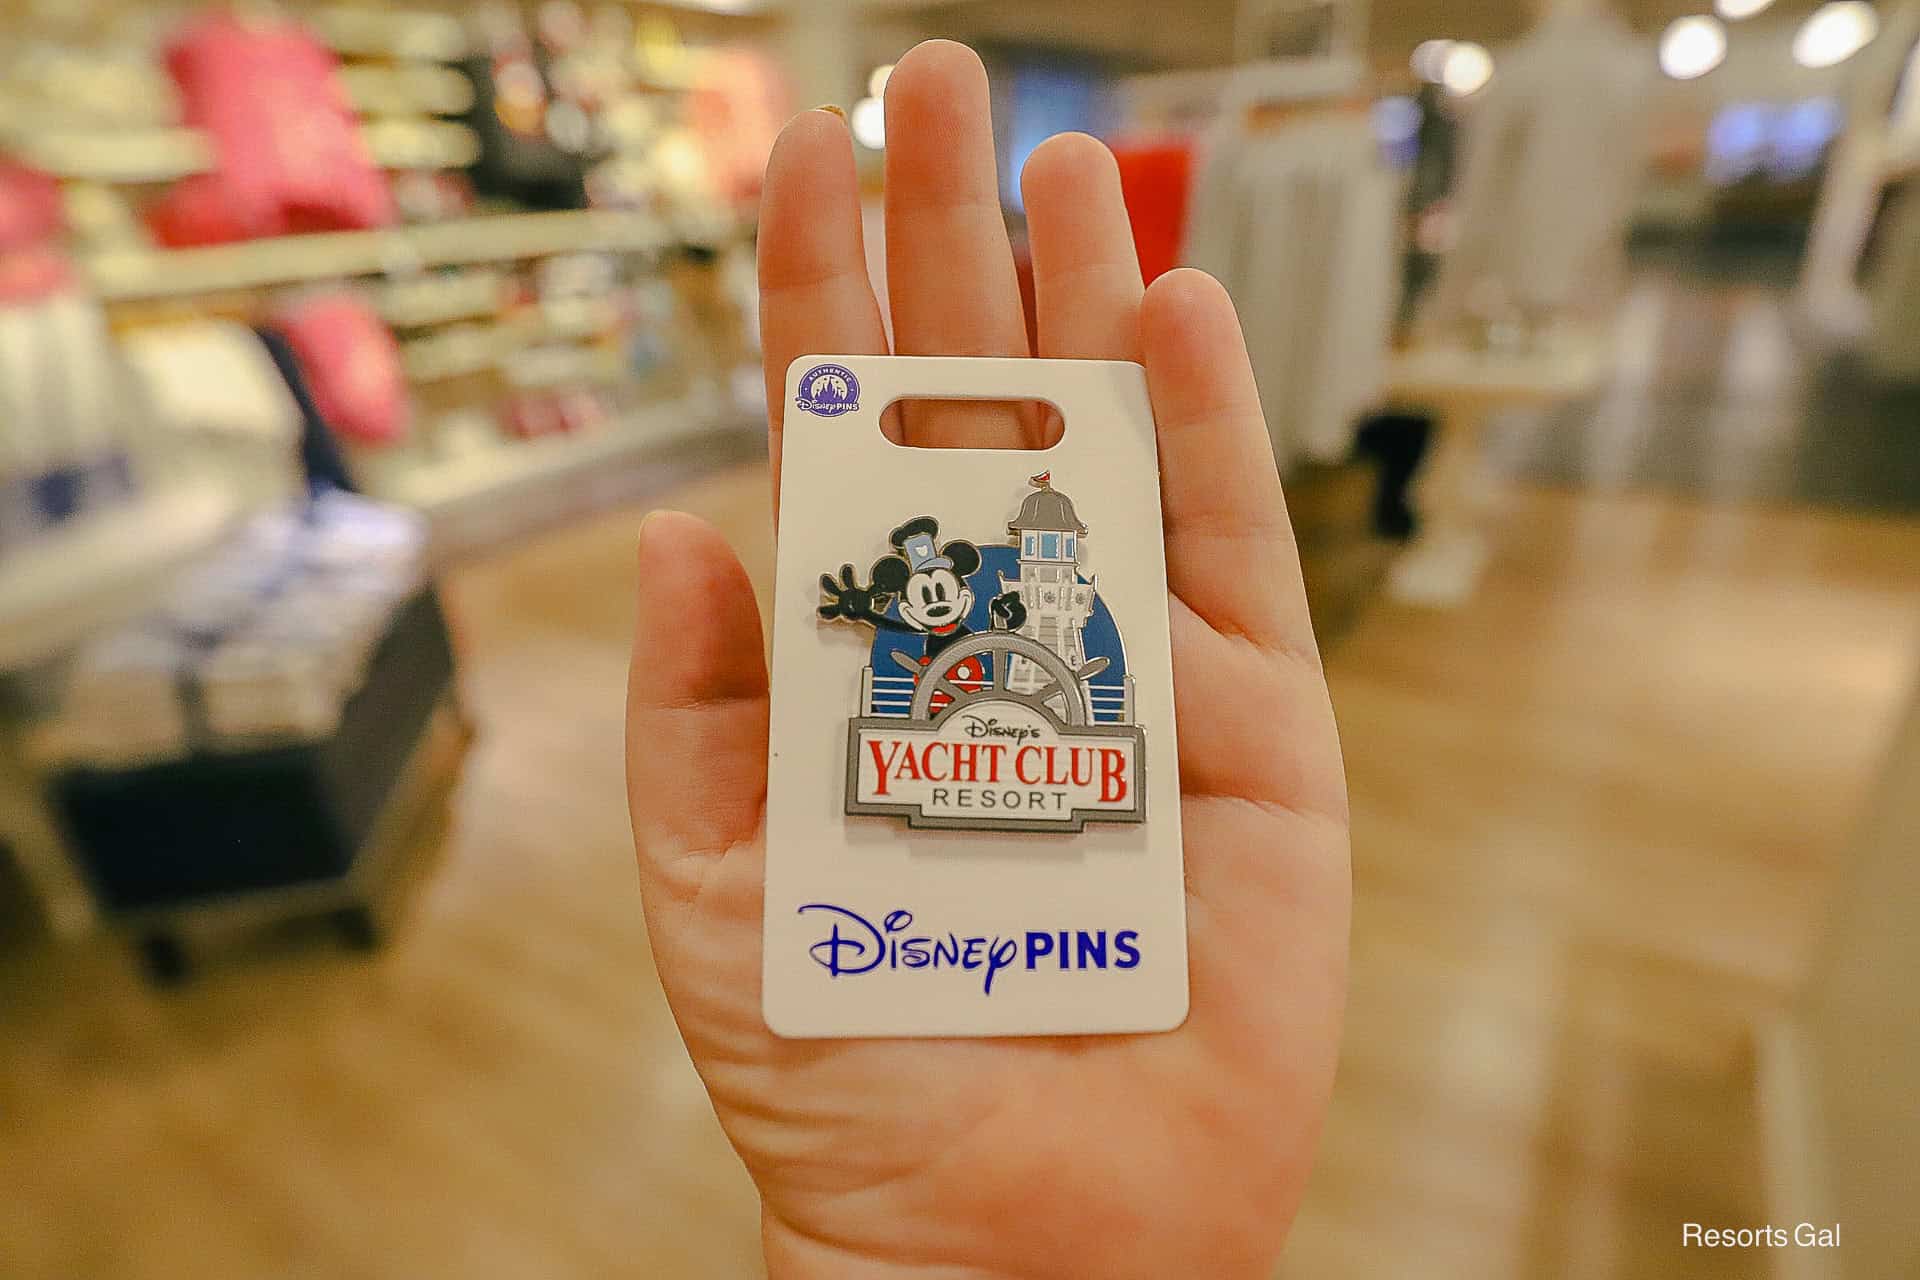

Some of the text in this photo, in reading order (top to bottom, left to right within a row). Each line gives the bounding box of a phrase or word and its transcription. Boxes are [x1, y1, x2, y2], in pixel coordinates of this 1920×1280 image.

[808, 367, 853, 383] AUTHENTIC
[961, 714, 1041, 746] Disney's
[867, 740, 1128, 803] YACHT CLUB
[931, 788, 1068, 811] RESORT
[1025, 929, 1142, 970] PINS
